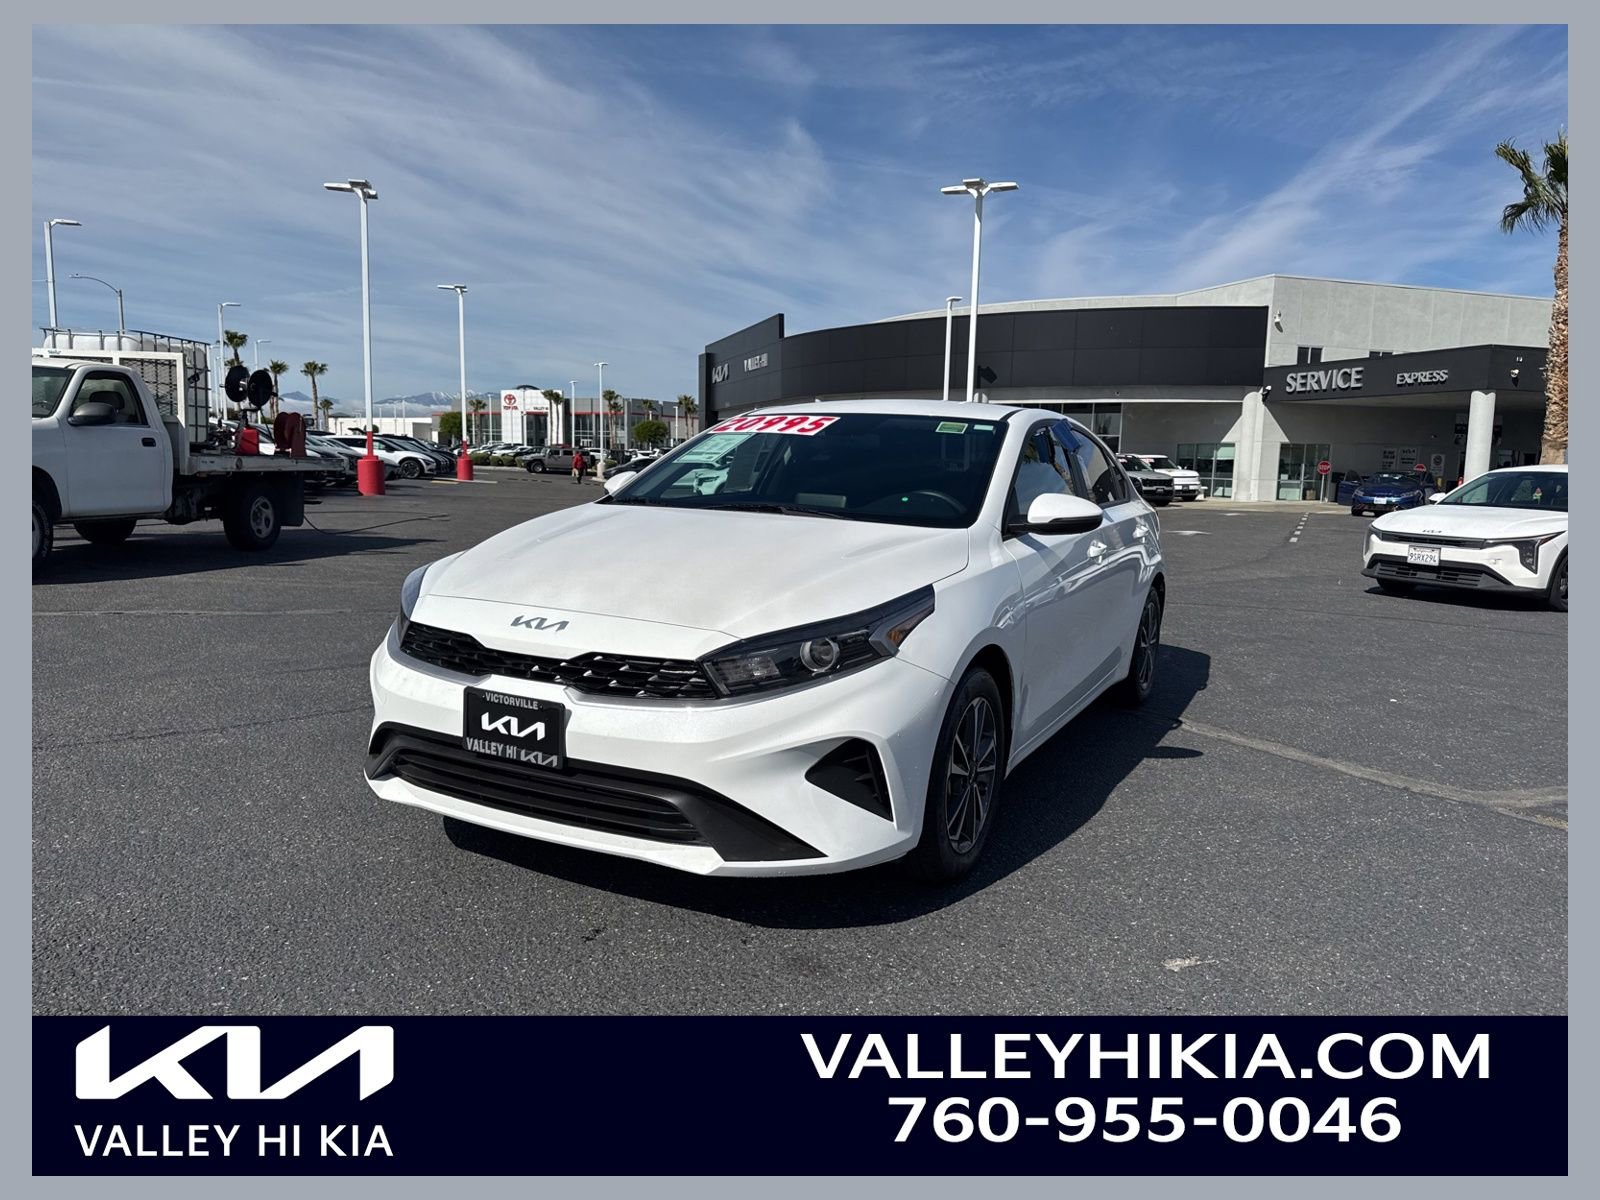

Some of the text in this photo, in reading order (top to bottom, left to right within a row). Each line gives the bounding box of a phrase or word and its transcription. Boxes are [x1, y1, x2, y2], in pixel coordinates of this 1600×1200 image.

[712, 363, 729, 384] KIA
[1285, 367, 1448, 392] SERVICE EXPRESS
[713, 415, 835, 433] 20995
[510, 614, 569, 632] KIA
[485, 691, 539, 710] VICTORVILLE
[481, 712, 545, 741] KIA
[466, 737, 558, 768] VALLEY HI KIA
